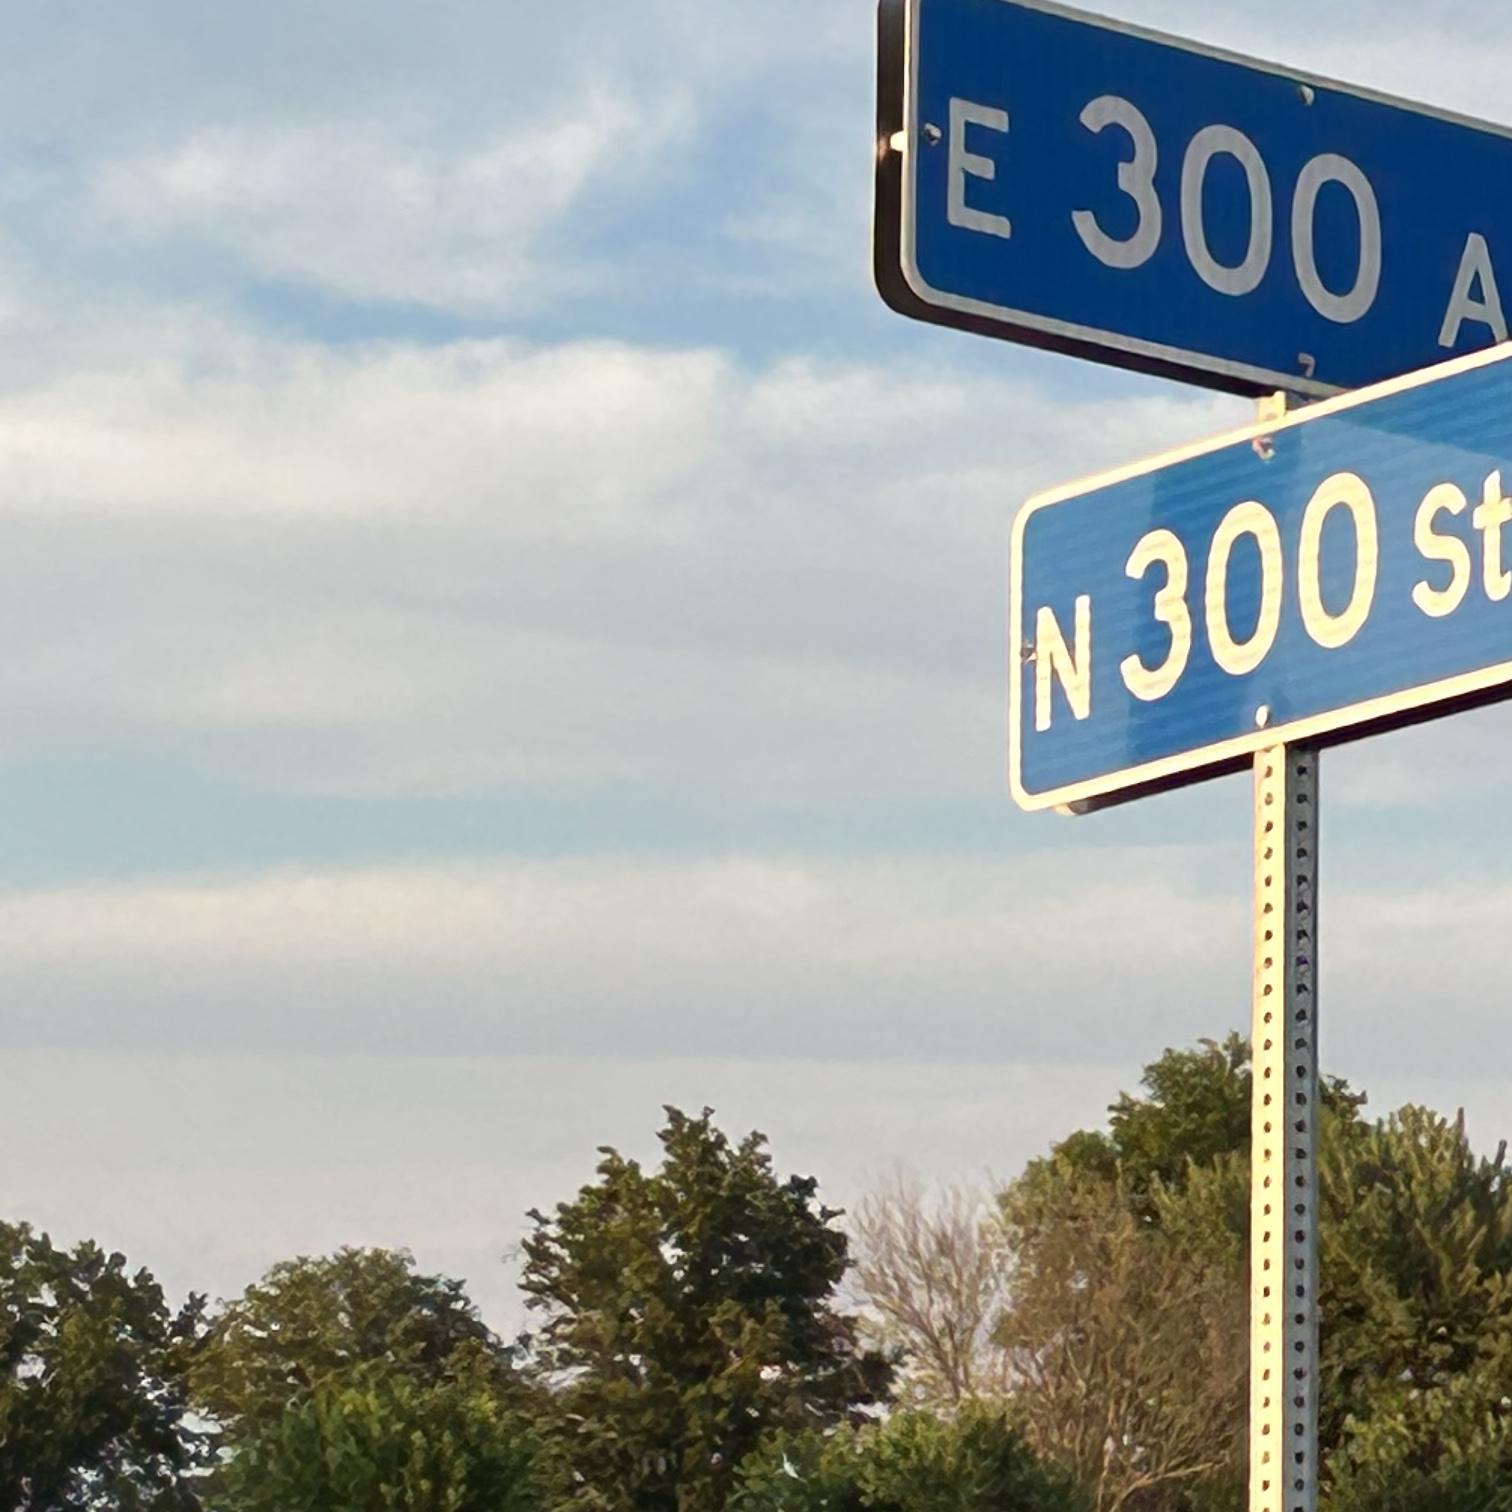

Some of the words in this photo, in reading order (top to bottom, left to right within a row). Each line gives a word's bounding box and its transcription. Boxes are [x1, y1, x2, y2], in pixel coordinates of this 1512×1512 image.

[946, 97, 1012, 240] E
[1071, 94, 1383, 324] 300
[1034, 594, 1091, 732] N
[1120, 472, 1379, 702] 300
